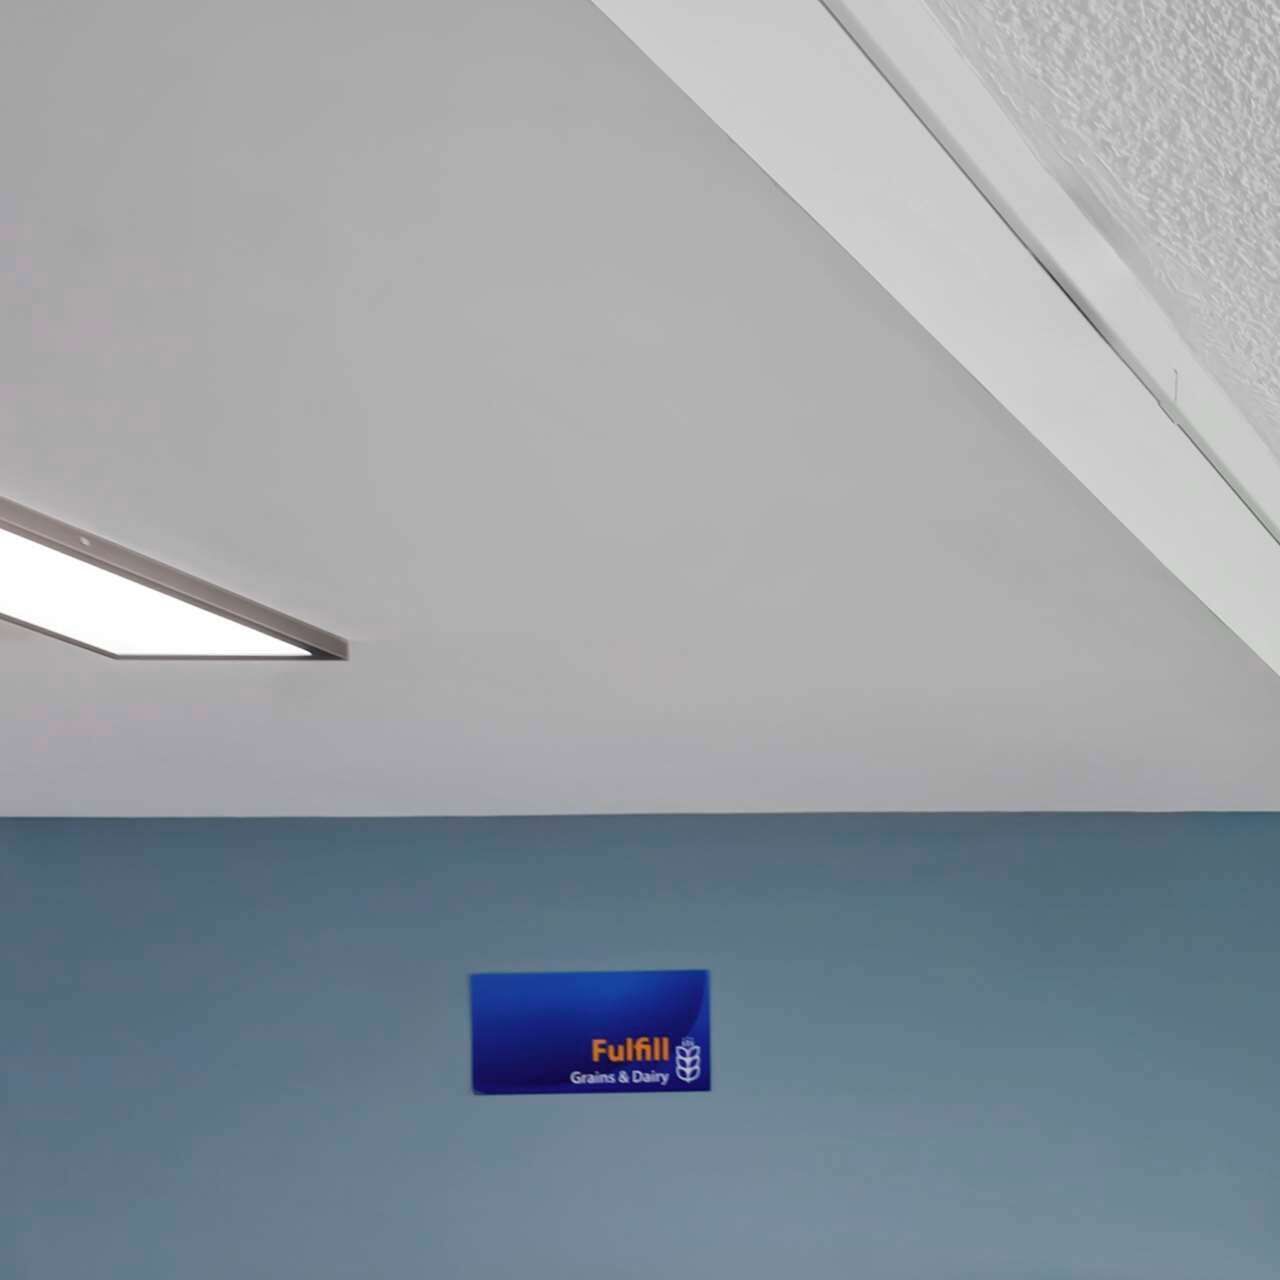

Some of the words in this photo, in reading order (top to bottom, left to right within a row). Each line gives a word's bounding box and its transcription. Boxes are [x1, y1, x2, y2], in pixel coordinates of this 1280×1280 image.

[591, 1036, 670, 1062] Fulfill
[569, 1070, 616, 1085] Grains
[618, 1070, 629, 1084] &
[632, 1069, 670, 1086] Dairy
